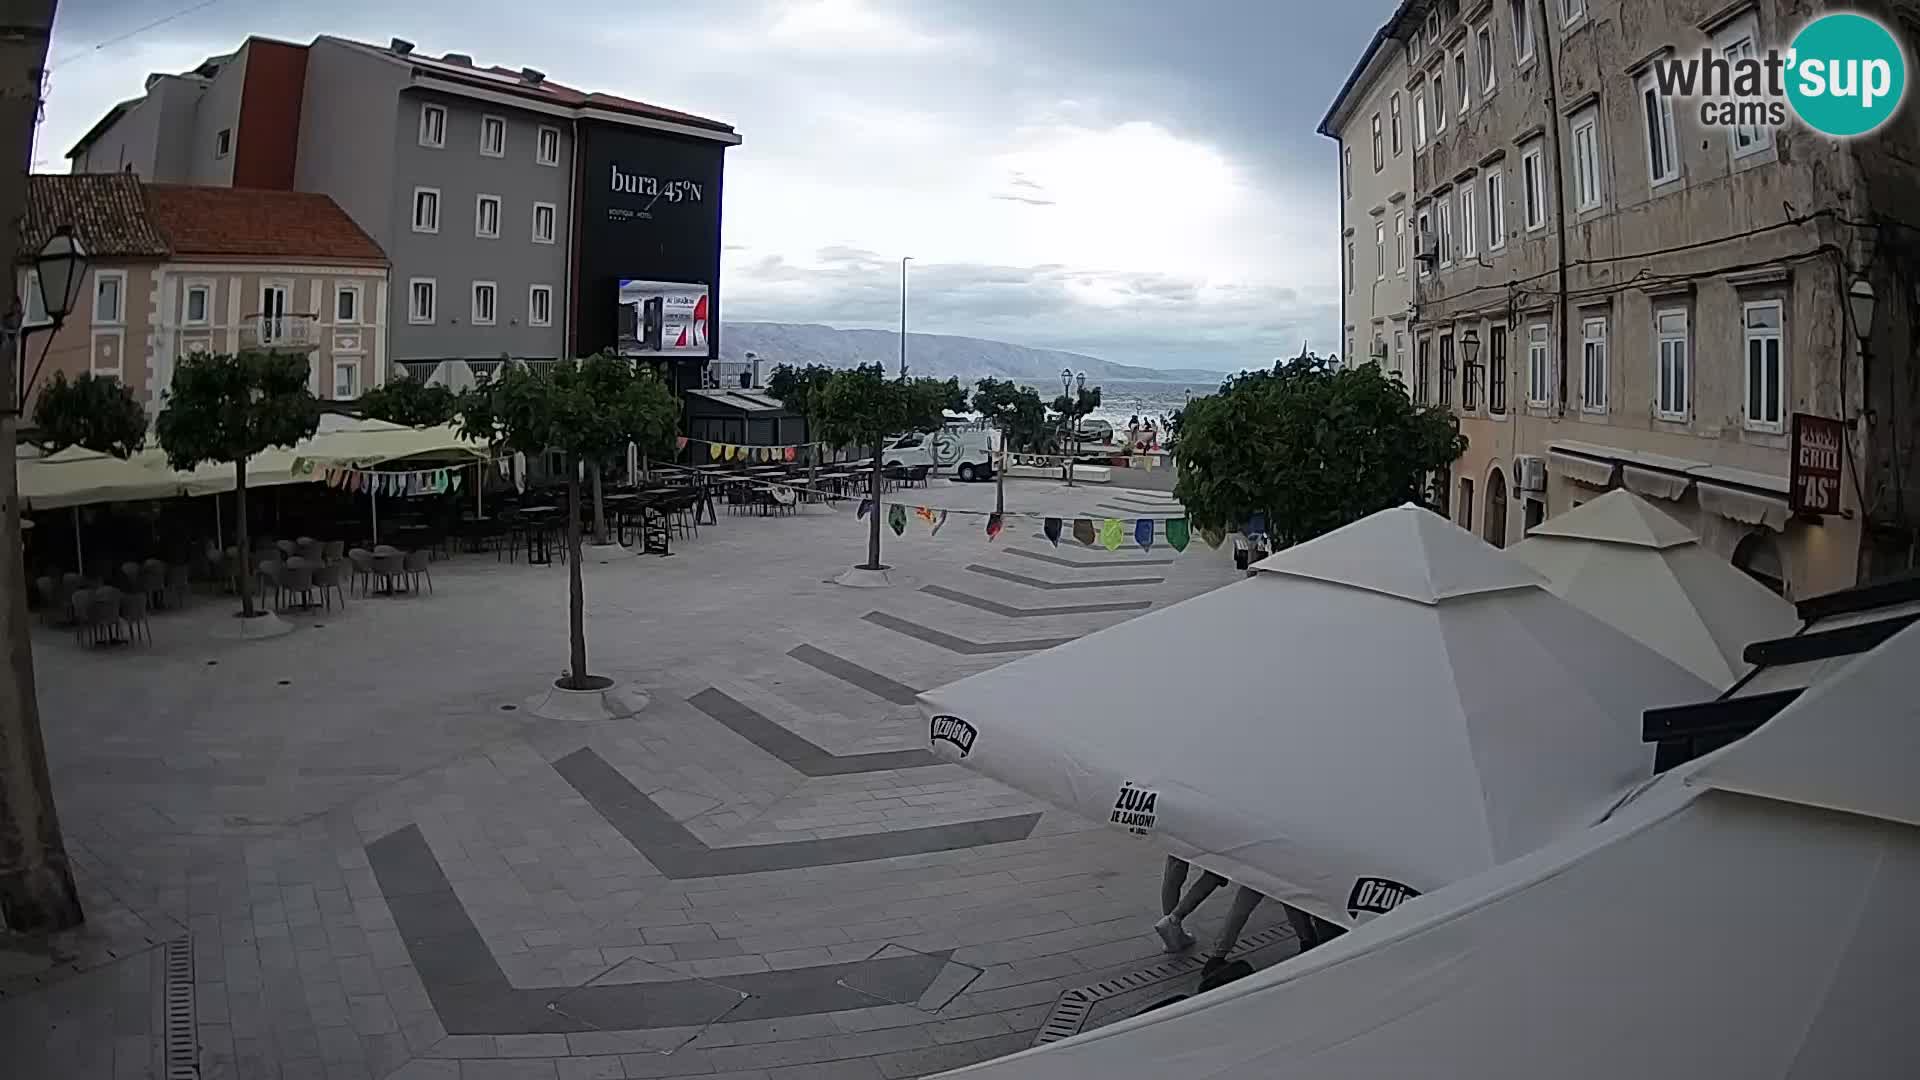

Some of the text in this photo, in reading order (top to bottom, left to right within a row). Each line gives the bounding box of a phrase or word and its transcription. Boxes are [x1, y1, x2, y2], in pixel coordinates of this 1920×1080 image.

[611, 165, 657, 196] bura
[1799, 447, 1839, 471] GRILL
[1115, 781, 1157, 813] ŽUJA
